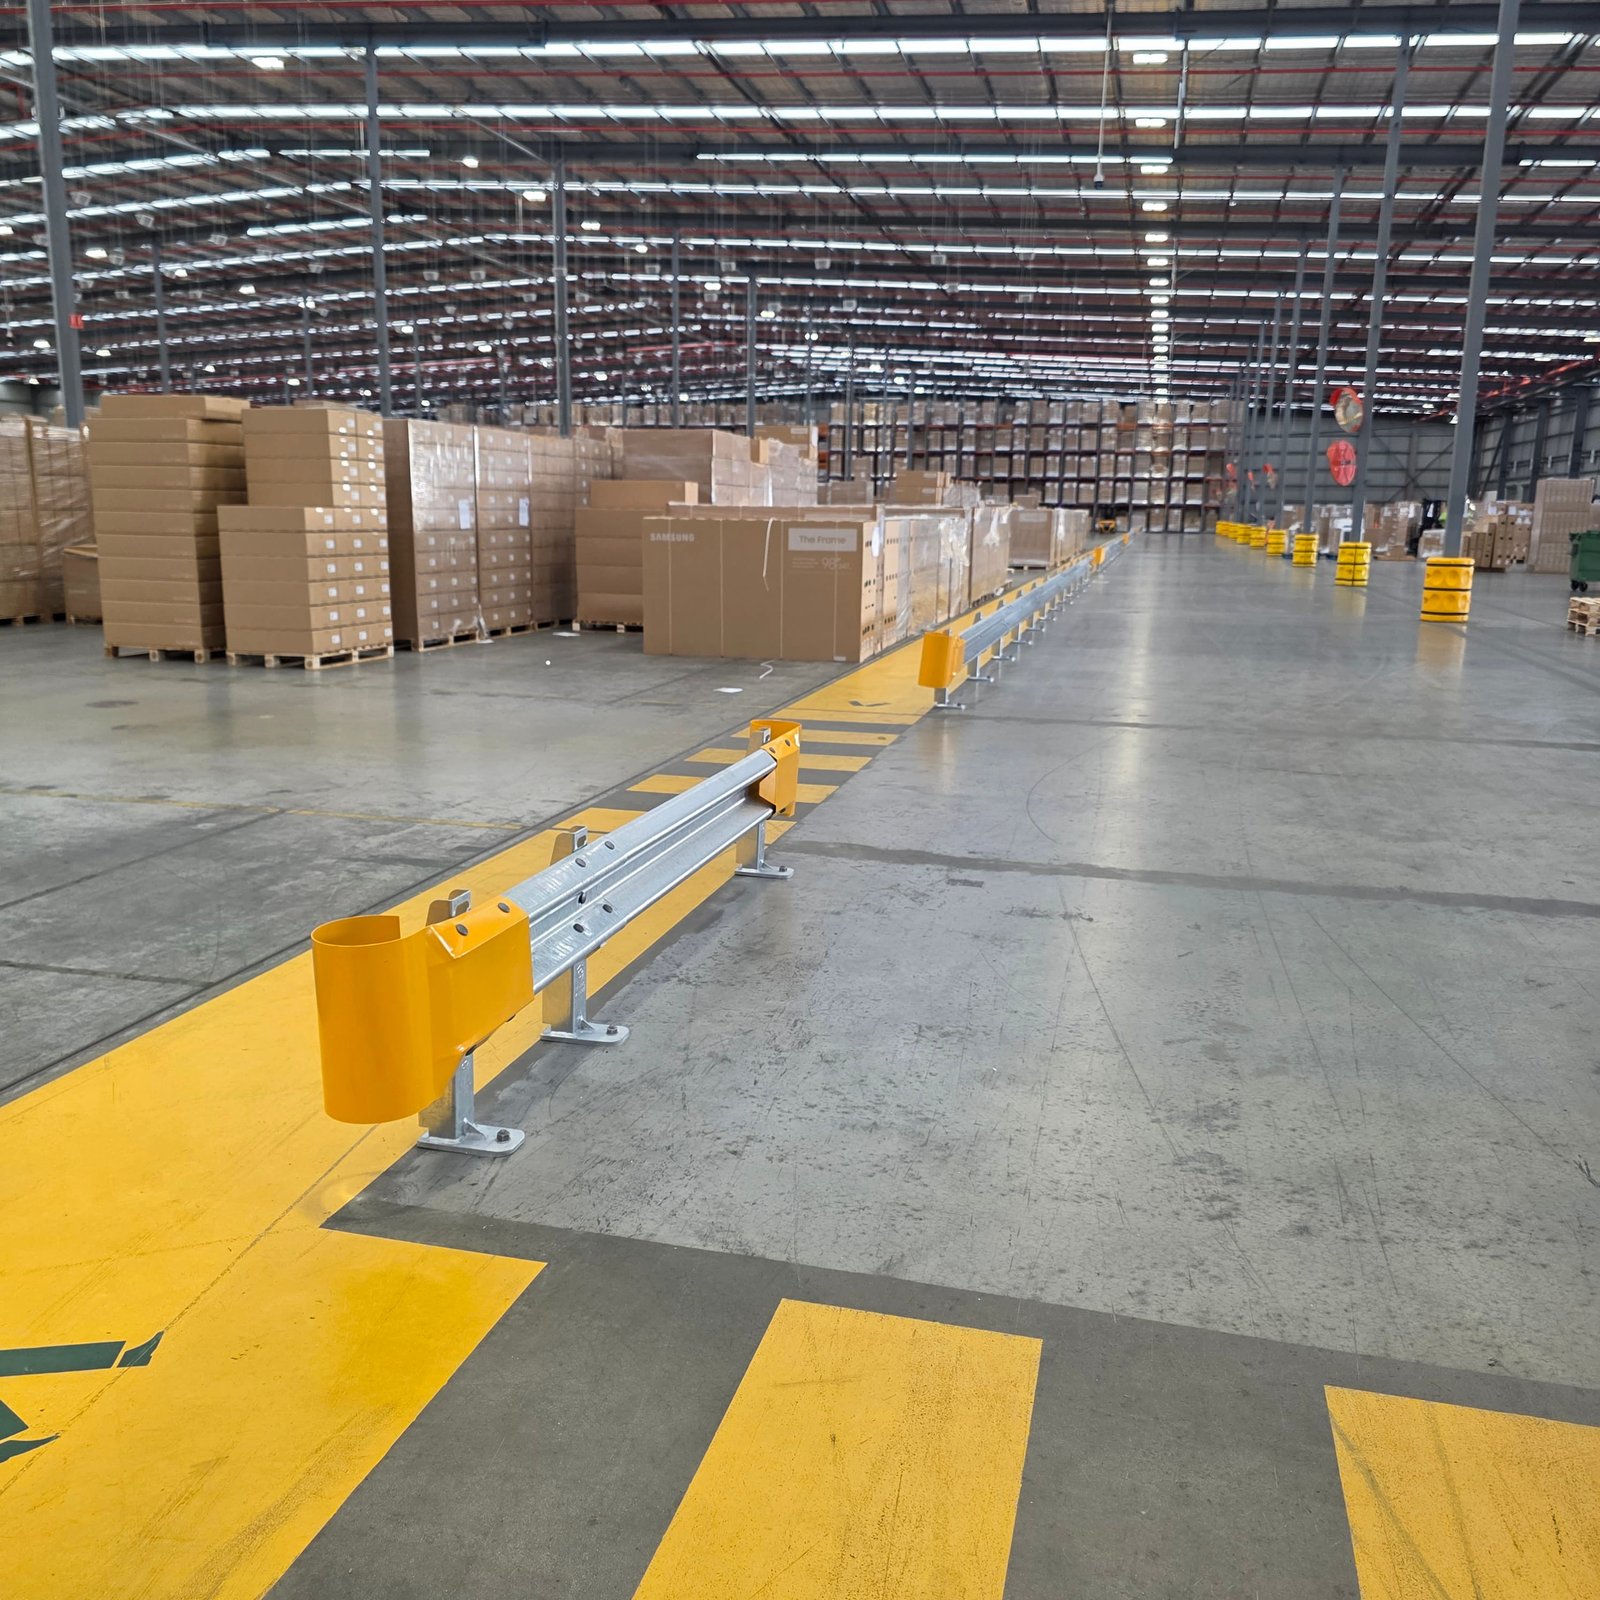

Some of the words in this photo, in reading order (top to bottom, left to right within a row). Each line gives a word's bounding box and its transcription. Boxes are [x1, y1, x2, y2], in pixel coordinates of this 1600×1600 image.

[650, 532, 695, 542] SAMSUNG
[799, 535, 816, 544] The
[817, 535, 847, 545] Frame
